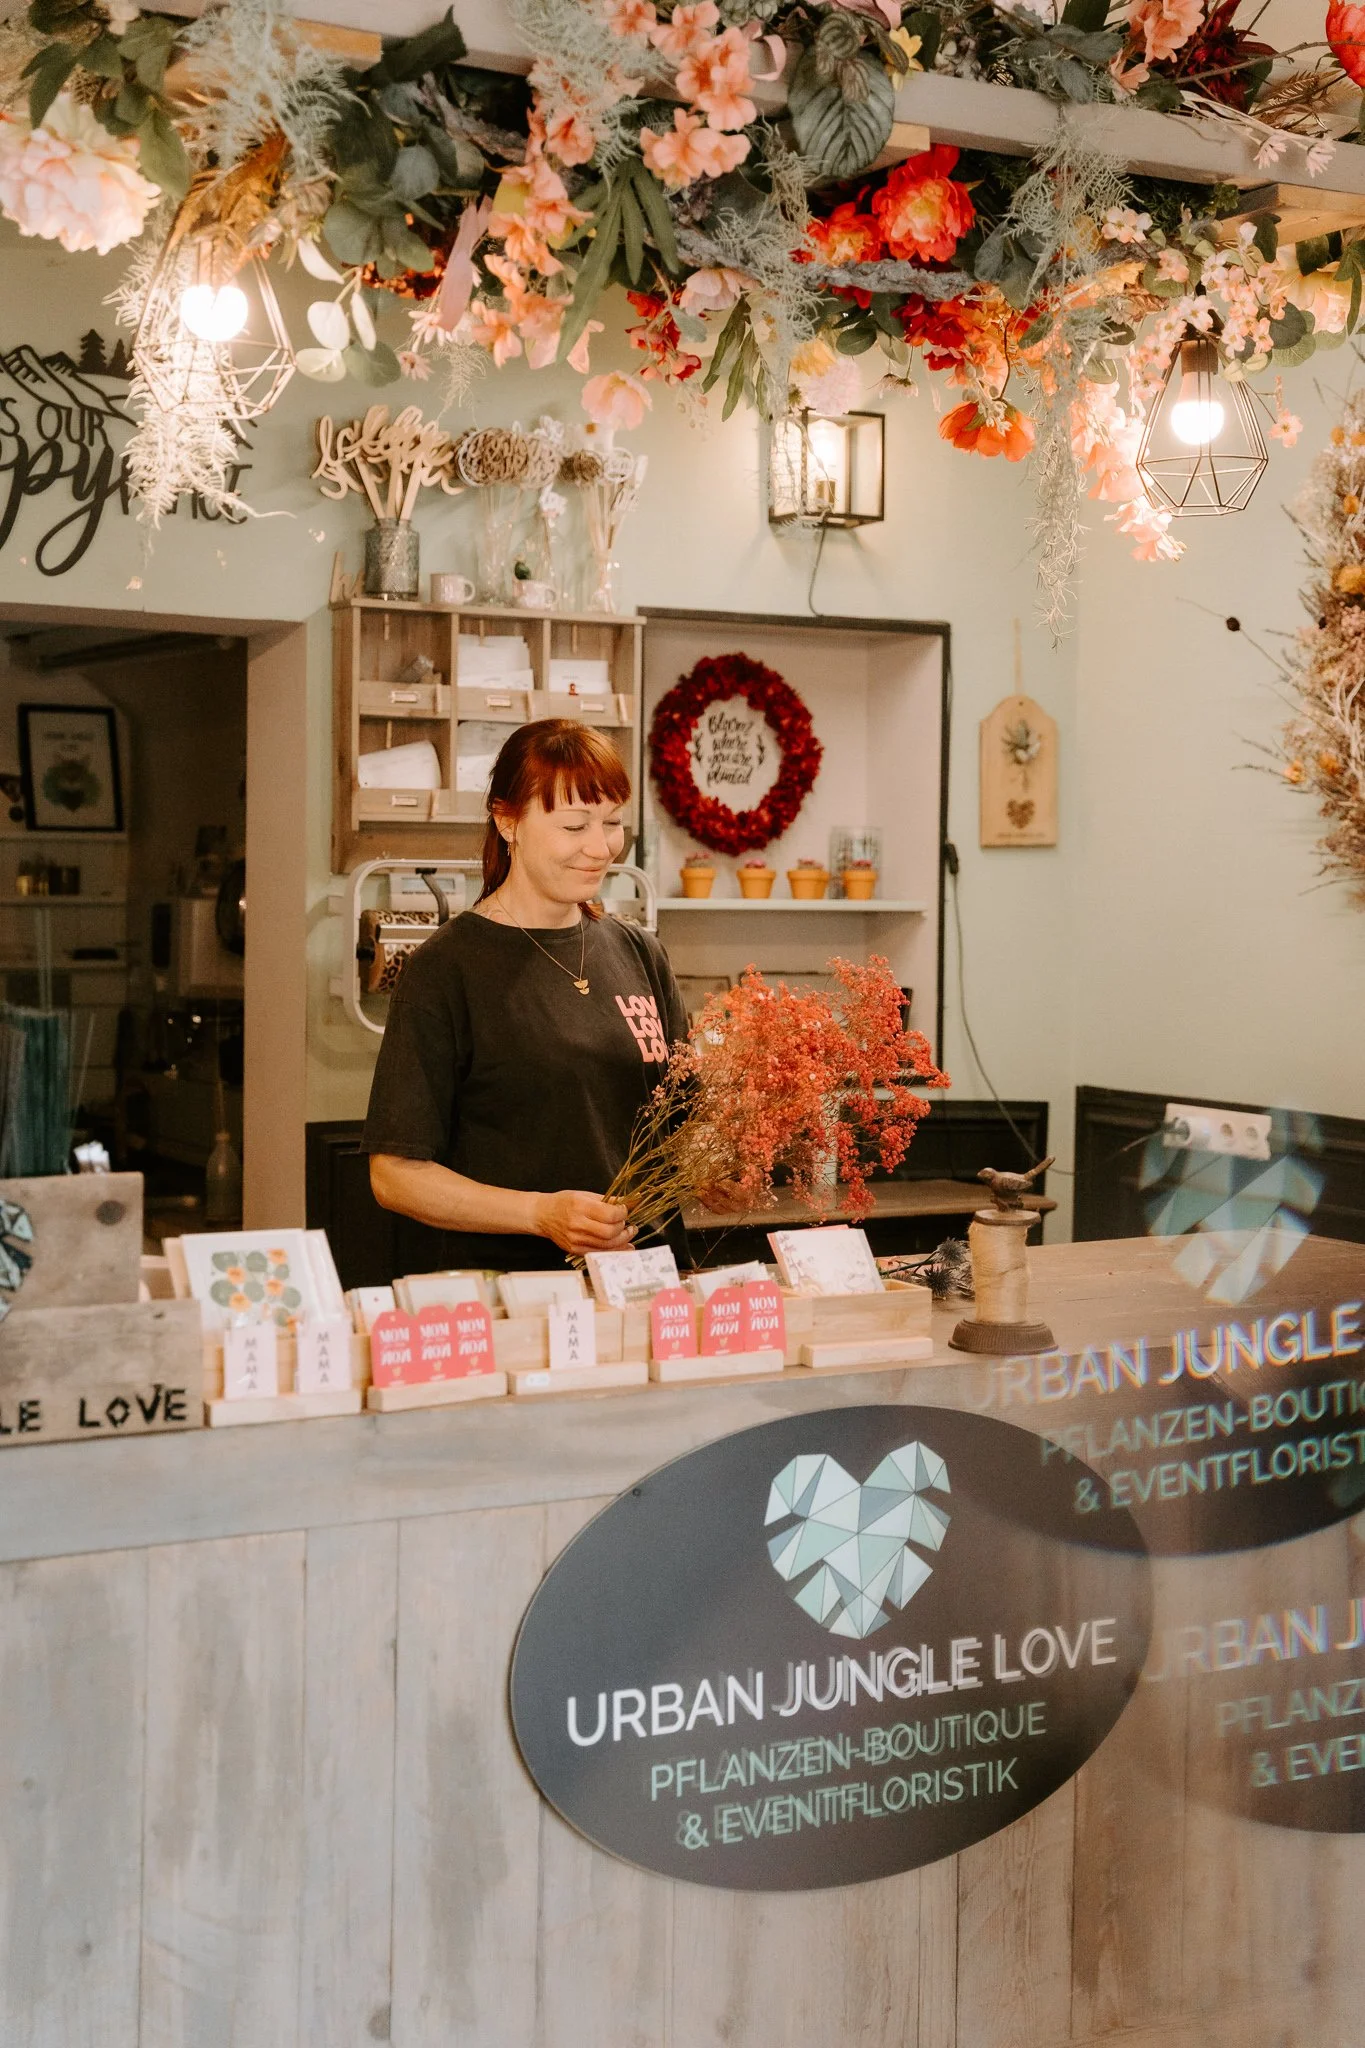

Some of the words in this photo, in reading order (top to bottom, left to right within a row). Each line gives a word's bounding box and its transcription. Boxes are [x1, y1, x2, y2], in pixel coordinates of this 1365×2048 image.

[37, 403, 109, 446] OUR
[659, 1304, 689, 1318] MOM
[711, 1302, 740, 1317] MOM
[748, 1296, 777, 1311] MOM
[1158, 1301, 1364, 1387] JUNGLE
[79, 1385, 187, 1428] LOVE
[1074, 1478, 1100, 1514] &
[565, 1671, 764, 1748] URBAN
[775, 1635, 982, 1720] JUNGLE
[993, 1616, 1118, 1685] LOVE
[650, 1700, 1048, 1800] PFLANZEN-BOUTIQUE
[1252, 1751, 1280, 1788] &
[682, 1813, 710, 1850] &
[721, 1756, 1020, 1844] EVENTFLORISTIK
